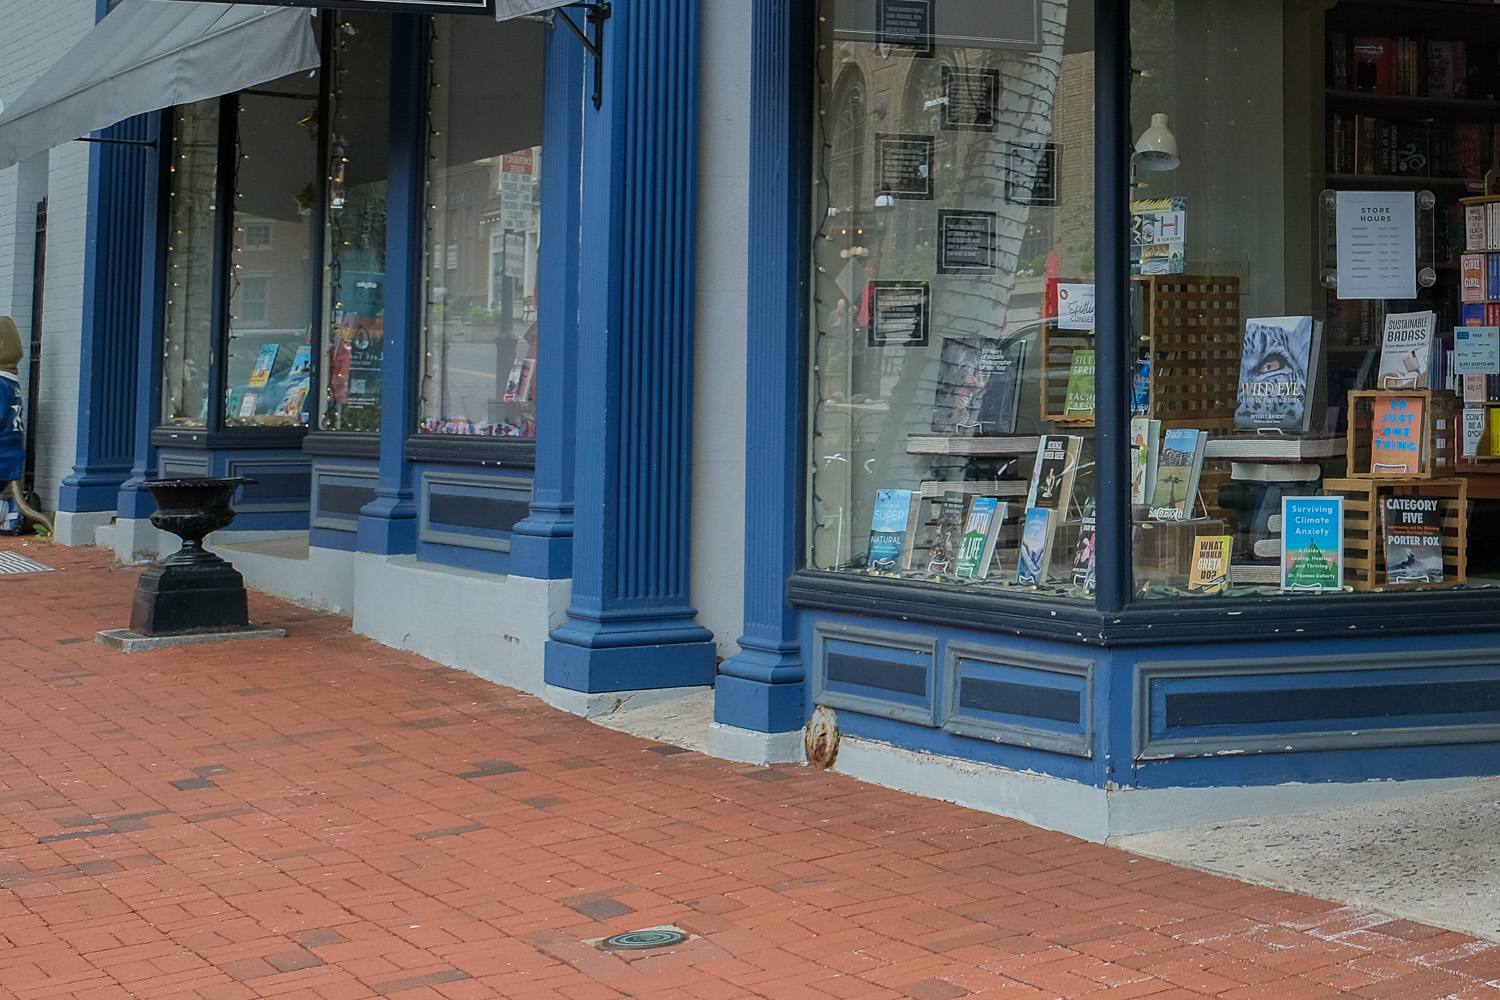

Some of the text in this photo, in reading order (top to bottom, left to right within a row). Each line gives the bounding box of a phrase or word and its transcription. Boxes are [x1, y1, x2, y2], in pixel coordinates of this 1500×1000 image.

[1388, 316, 1428, 331] SUSTAINABLE
[1387, 328, 1426, 342] BADASS
[1242, 381, 1301, 396] WILD EYE
[1390, 399, 1408, 410] DO
[1381, 412, 1415, 424] JUST
[1383, 426, 1411, 437] ONE
[1375, 439, 1417, 451] THING
[1292, 505, 1334, 515] Surviving
[1386, 498, 1438, 511] CATEGORY
[874, 509, 905, 521] SUPER
[1295, 516, 1330, 524] Climate
[1402, 512, 1424, 524] FIVE
[1295, 528, 1329, 537] Anxiety
[871, 535, 902, 544] NATURAL
[1200, 540, 1223, 550] WHAT
[1388, 535, 1440, 546] PORTER FOX
[966, 537, 983, 560] LIFE
[1199, 550, 1222, 559] WOULD
[1197, 558, 1222, 570] GRETA
[1200, 571, 1217, 580] DO?
